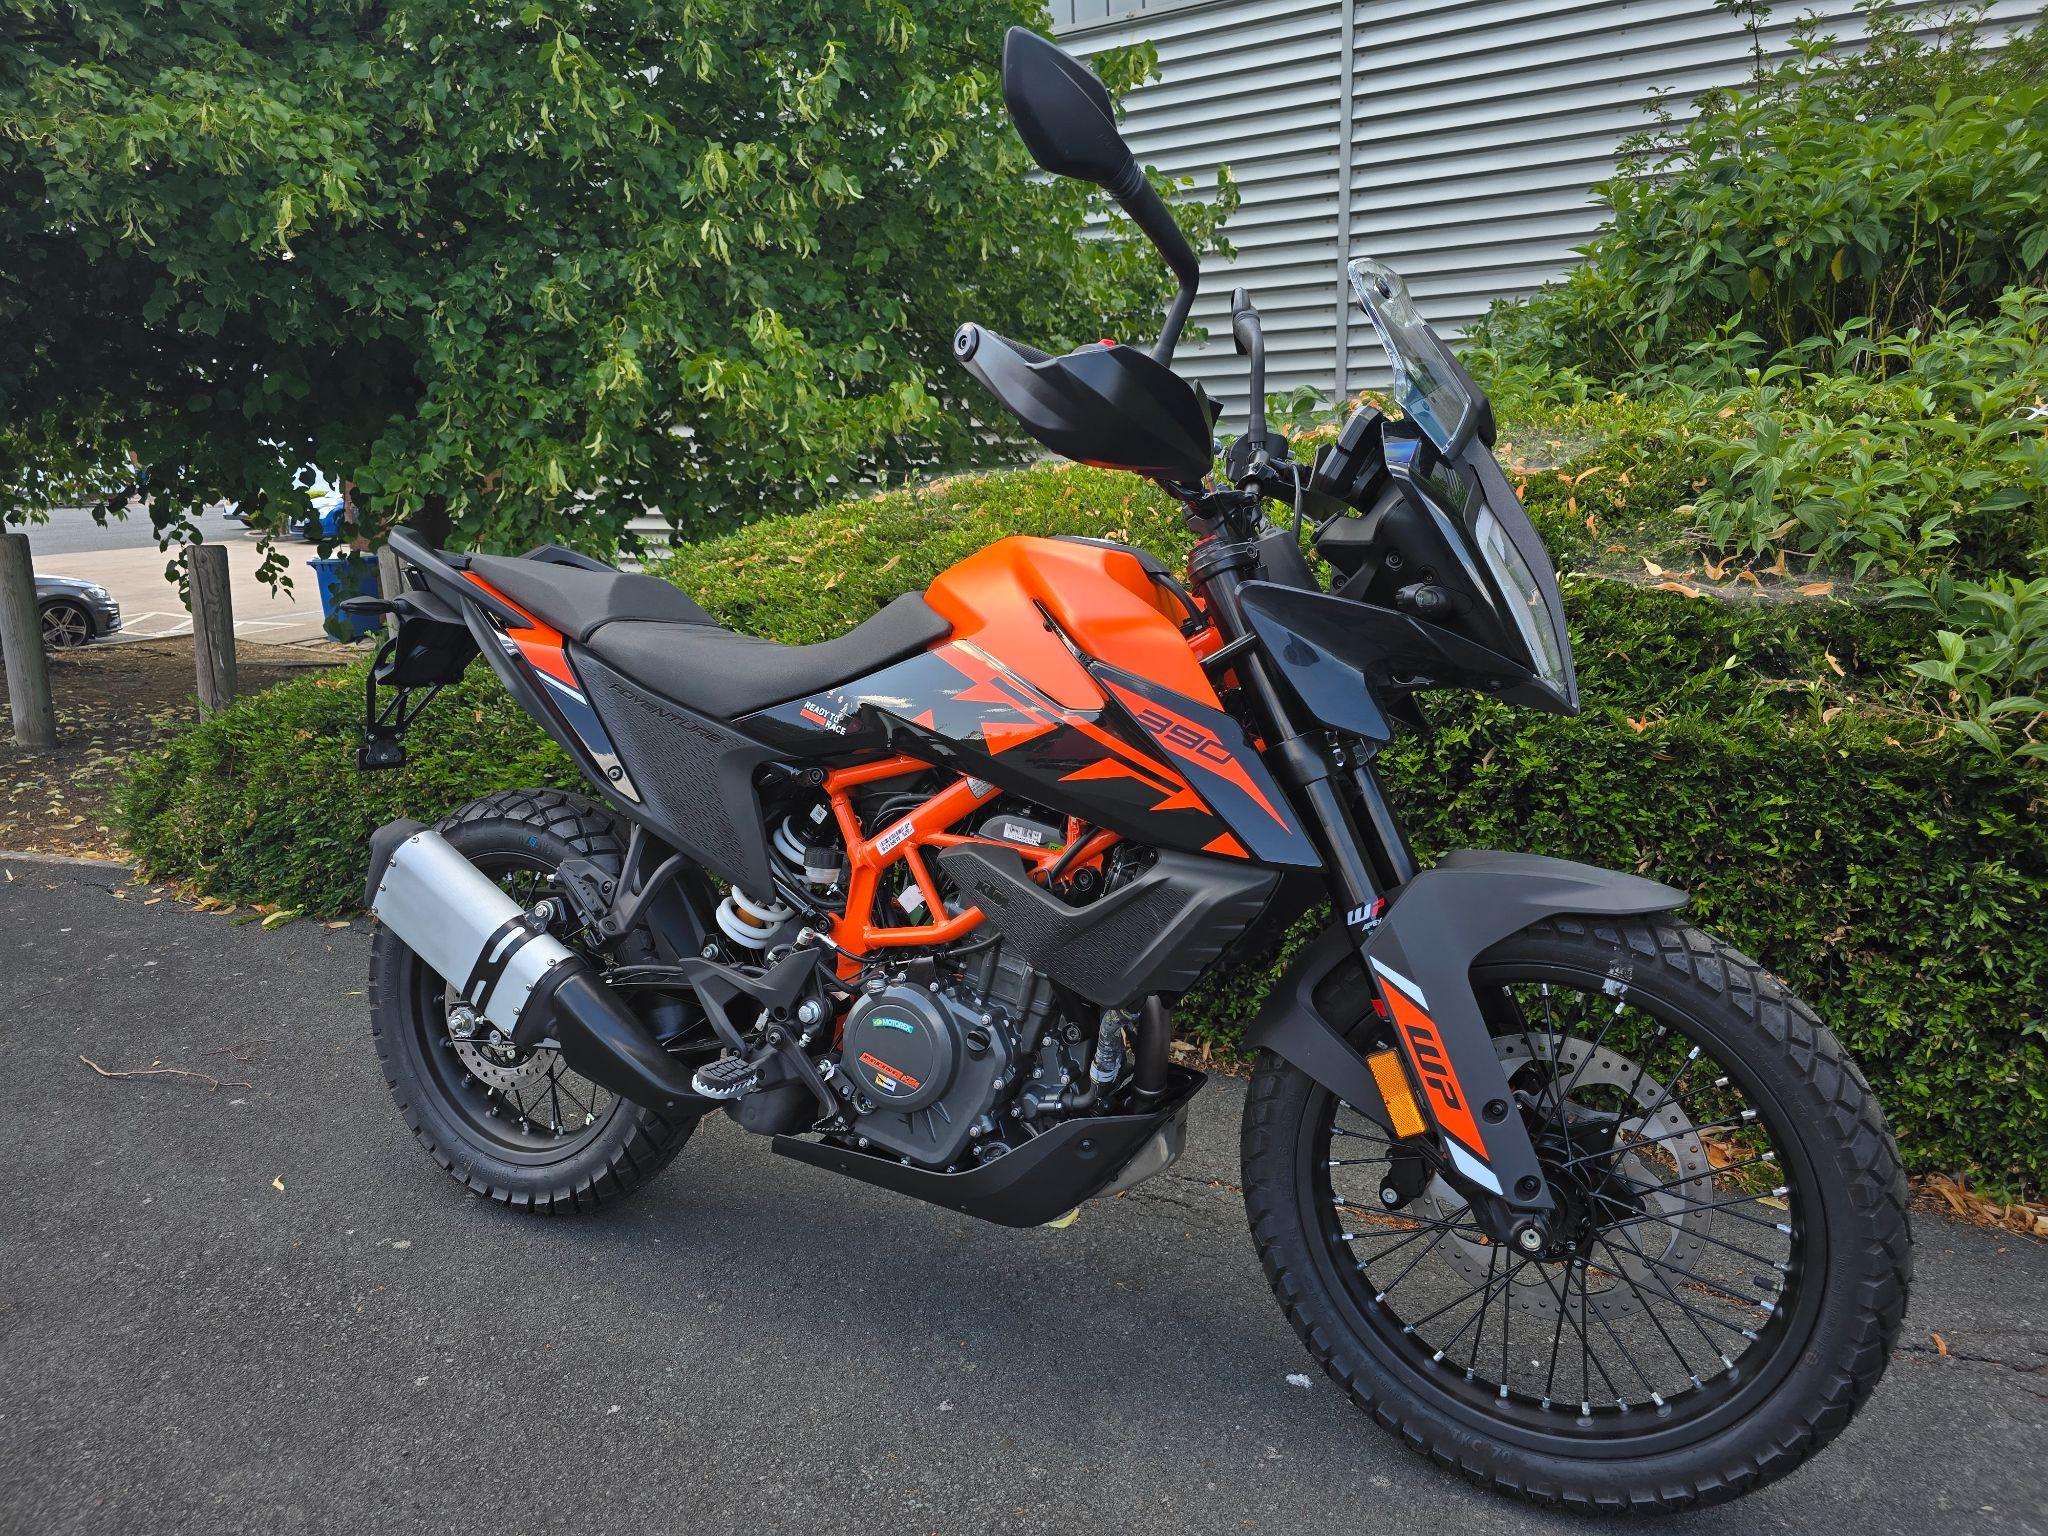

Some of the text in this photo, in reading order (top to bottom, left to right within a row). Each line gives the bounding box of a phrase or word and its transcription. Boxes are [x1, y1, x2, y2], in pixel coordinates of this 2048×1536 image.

[609, 683, 726, 743] ADVENTURE
[804, 701, 841, 723] READY TO
[825, 720, 847, 736] RACE
[1137, 708, 1233, 765] 390
[1347, 897, 1385, 926] WP
[882, 1018, 914, 1034] MOTOREX
[1404, 1023, 1463, 1112] WP
